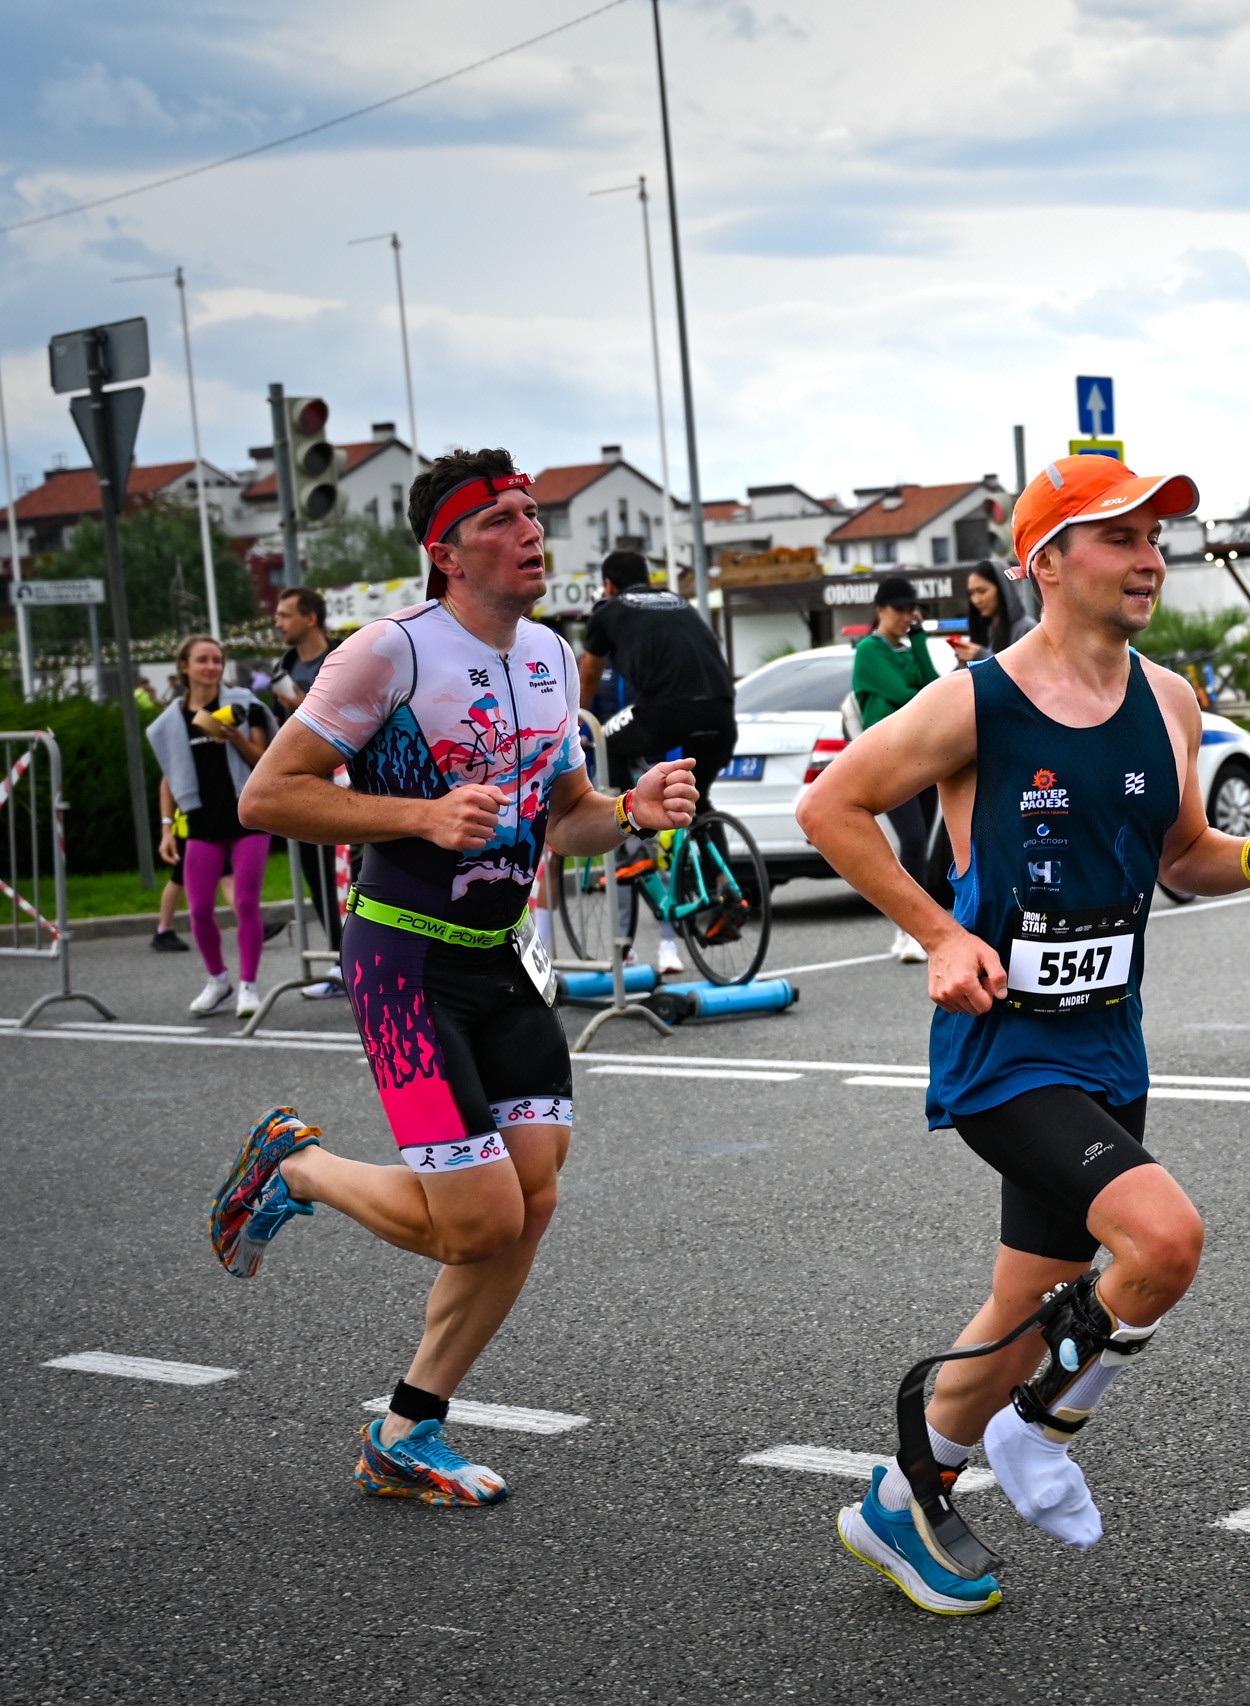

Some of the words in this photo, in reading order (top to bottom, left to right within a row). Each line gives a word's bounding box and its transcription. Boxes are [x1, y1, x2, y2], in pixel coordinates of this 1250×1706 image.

[1100, 496, 1128, 508] 2XU
[1022, 788, 1068, 801] ИНТЕР
[1023, 910, 1041, 922] IRON
[1021, 920, 1048, 934] STAR
[449, 930, 498, 946] POWE
[1038, 945, 1113, 987] 5547
[1059, 993, 1091, 1007] ANDREY
